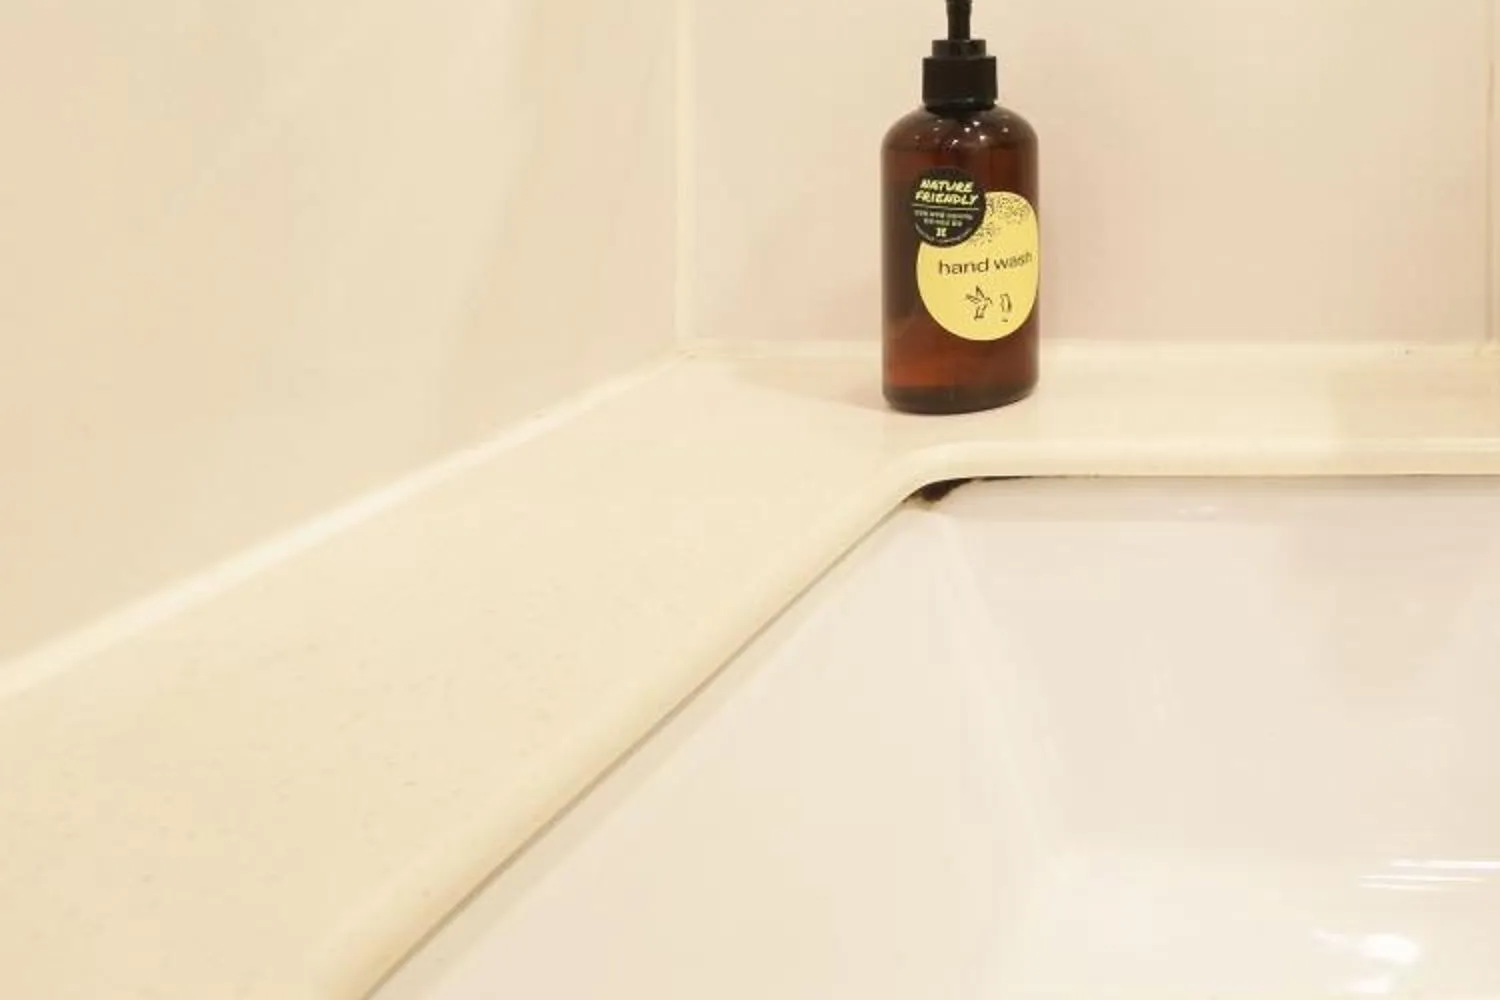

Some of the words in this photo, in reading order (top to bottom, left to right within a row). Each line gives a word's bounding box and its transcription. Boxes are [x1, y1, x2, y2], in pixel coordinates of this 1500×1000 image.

[920, 179, 974, 193] NATURE
[915, 189, 979, 205] FRIENDLY
[938, 258, 989, 276] hand
[993, 251, 1033, 271] wash
